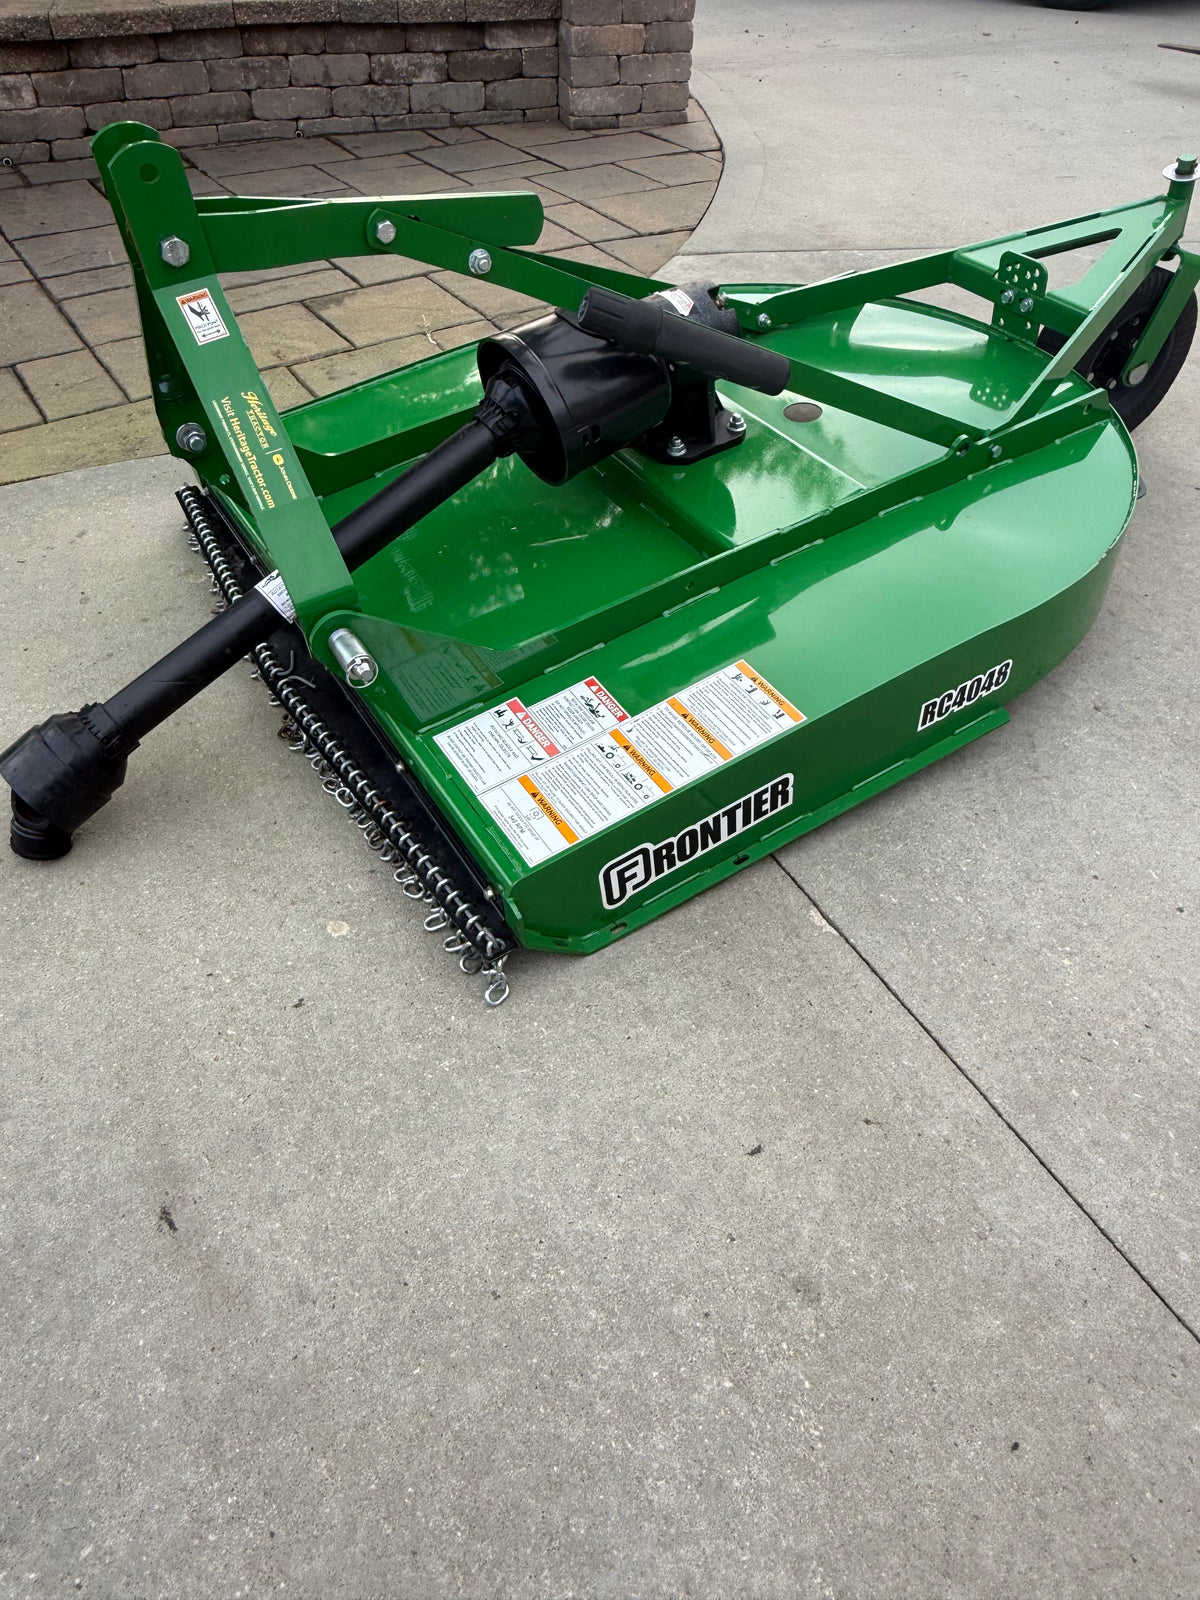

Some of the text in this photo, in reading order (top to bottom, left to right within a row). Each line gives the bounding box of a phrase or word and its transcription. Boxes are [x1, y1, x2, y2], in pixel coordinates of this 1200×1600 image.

[241, 390, 277, 438] Heritage
[246, 409, 269, 450] TRACTOR
[220, 395, 277, 510] Visit HeritageTractor.com
[278, 464, 297, 500] JOHN DEERE
[595, 690, 623, 718] DANGER
[755, 680, 786, 706] WARNING
[919, 660, 1012, 730] RC4048
[521, 717, 550, 747] DANGER
[686, 717, 716, 744] WARNING
[628, 749, 657, 776] WARNING
[536, 796, 563, 825] WARNING
[514, 822, 526, 834] RPM
[601, 774, 793, 909] FRONTIER
